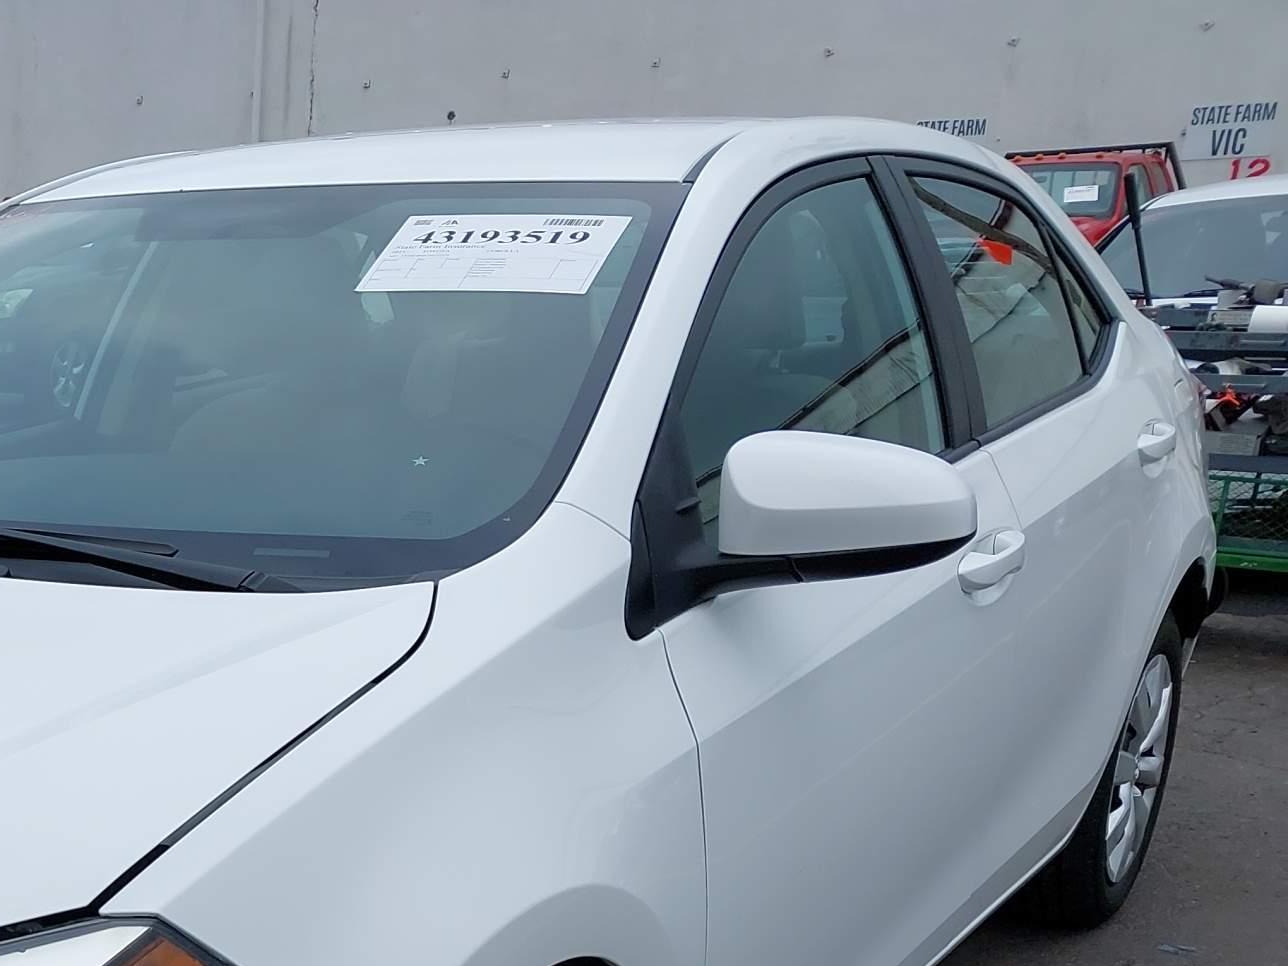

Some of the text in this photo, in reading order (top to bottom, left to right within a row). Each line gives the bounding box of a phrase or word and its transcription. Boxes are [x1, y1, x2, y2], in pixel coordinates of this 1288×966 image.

[1191, 102, 1278, 126] STATE FARM
[951, 118, 987, 137] FARM
[1211, 128, 1248, 156] VIC
[1230, 158, 1271, 180] 12
[413, 230, 591, 245] 43193519
